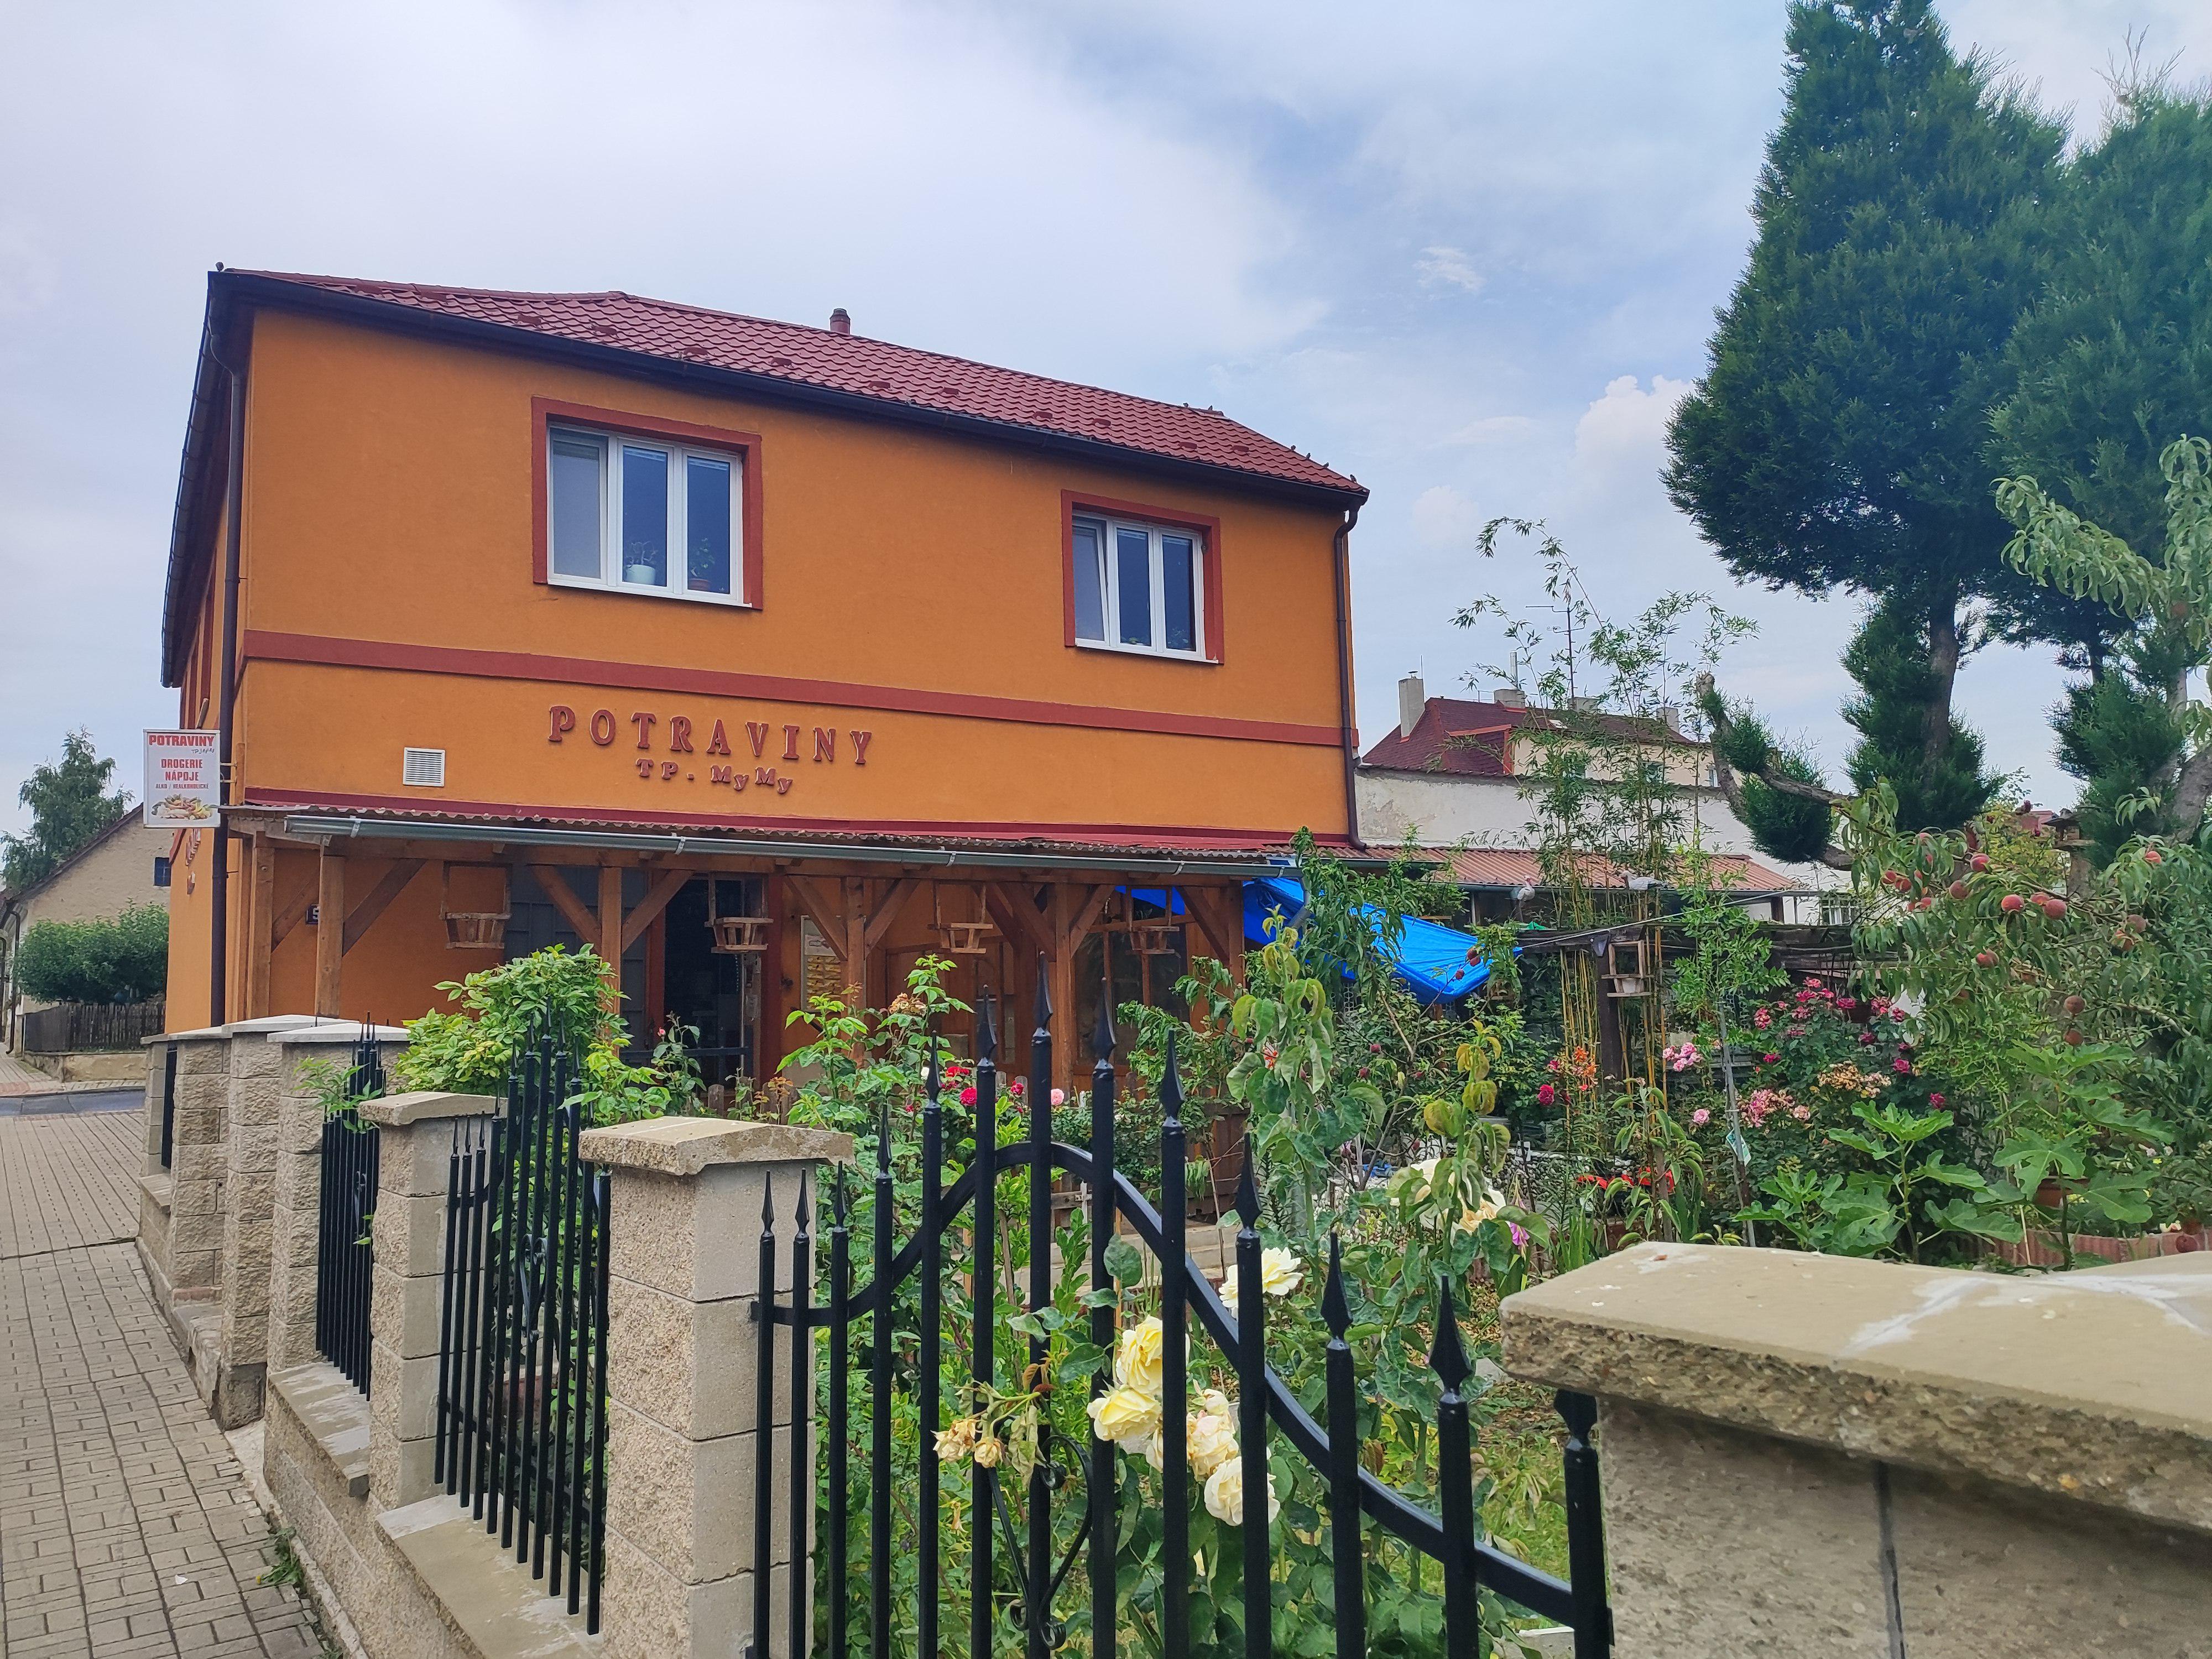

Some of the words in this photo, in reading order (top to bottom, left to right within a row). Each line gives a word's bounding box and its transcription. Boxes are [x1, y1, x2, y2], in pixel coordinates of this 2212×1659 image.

[149, 735, 215, 746] POTRAVINY
[548, 705, 872, 765] POTRAVINY
[161, 759, 203, 769] DROGERIE
[165, 770, 199, 781] NÁPOJE
[711, 764, 794, 795] MyMy
